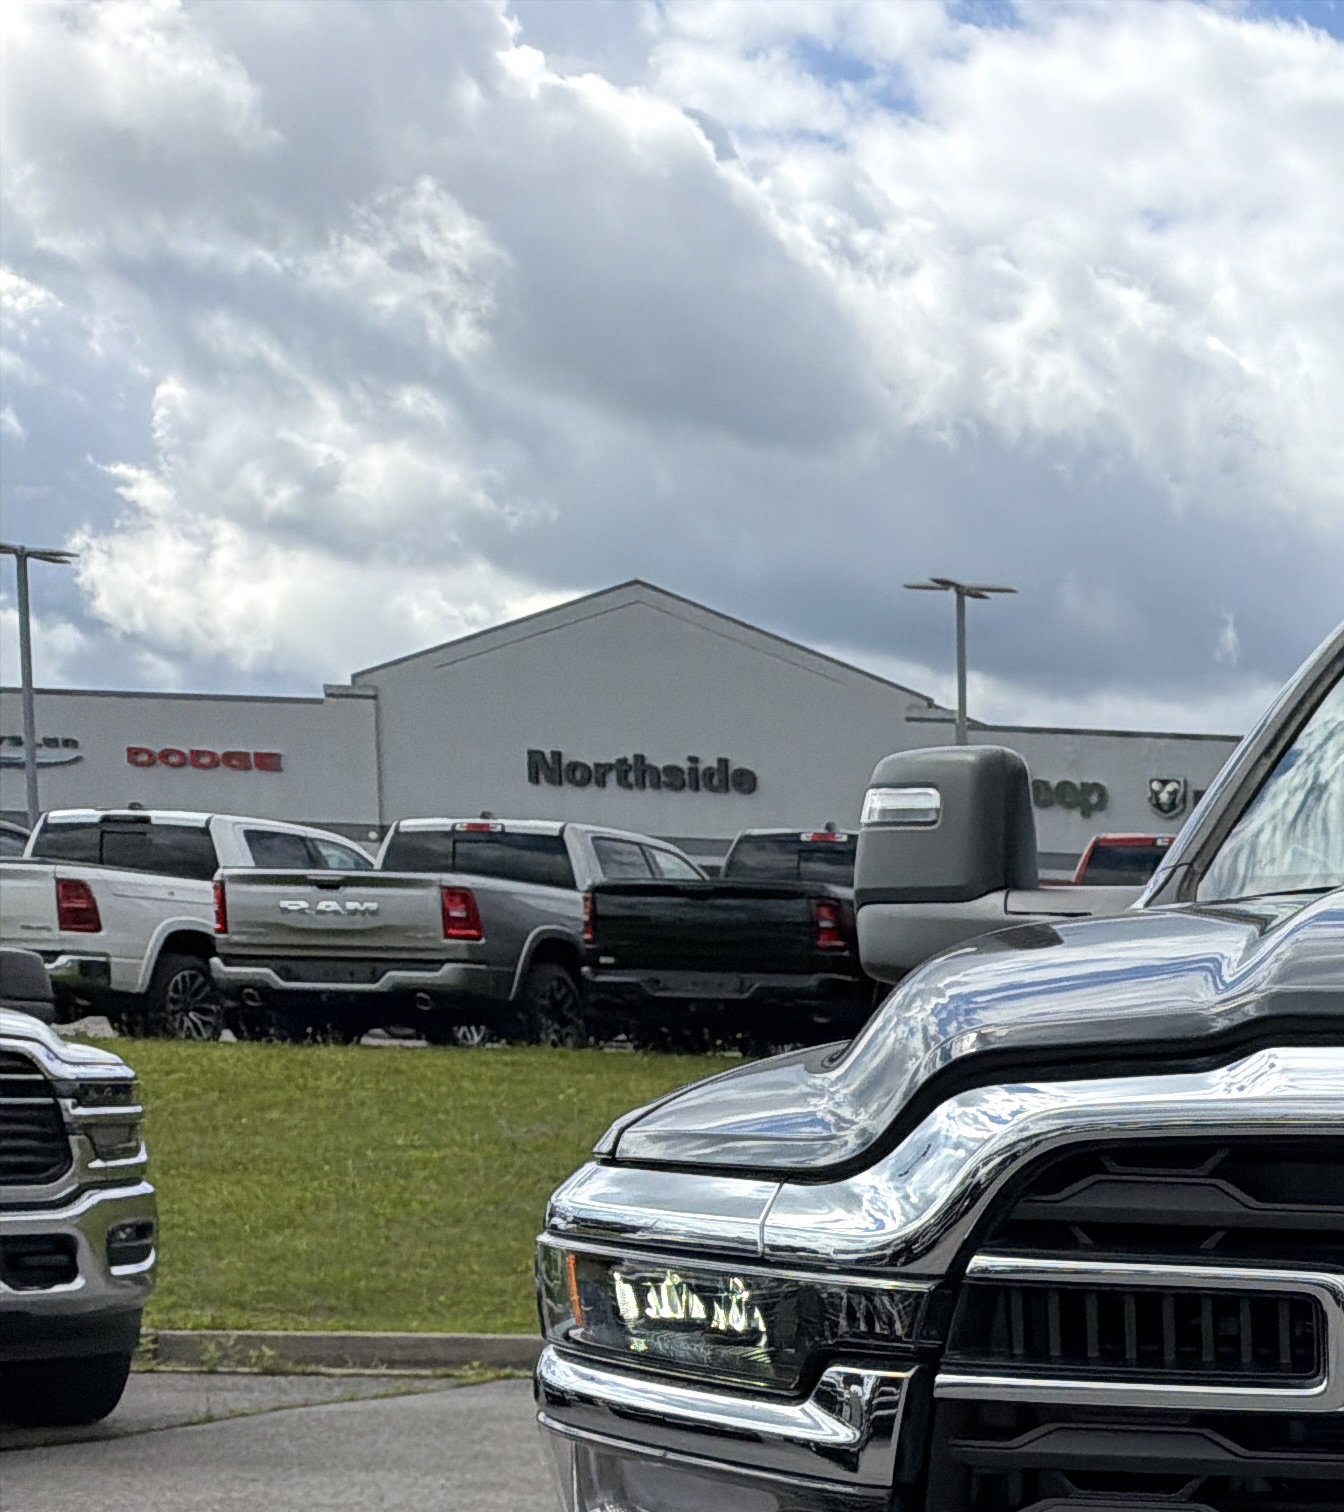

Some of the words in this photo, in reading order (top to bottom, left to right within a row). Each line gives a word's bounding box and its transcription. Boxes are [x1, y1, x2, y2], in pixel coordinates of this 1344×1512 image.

[126, 747, 284, 772] DODGE
[527, 749, 758, 795] Northside
[1032, 778, 1109, 818] eep
[279, 900, 378, 916] RAM
